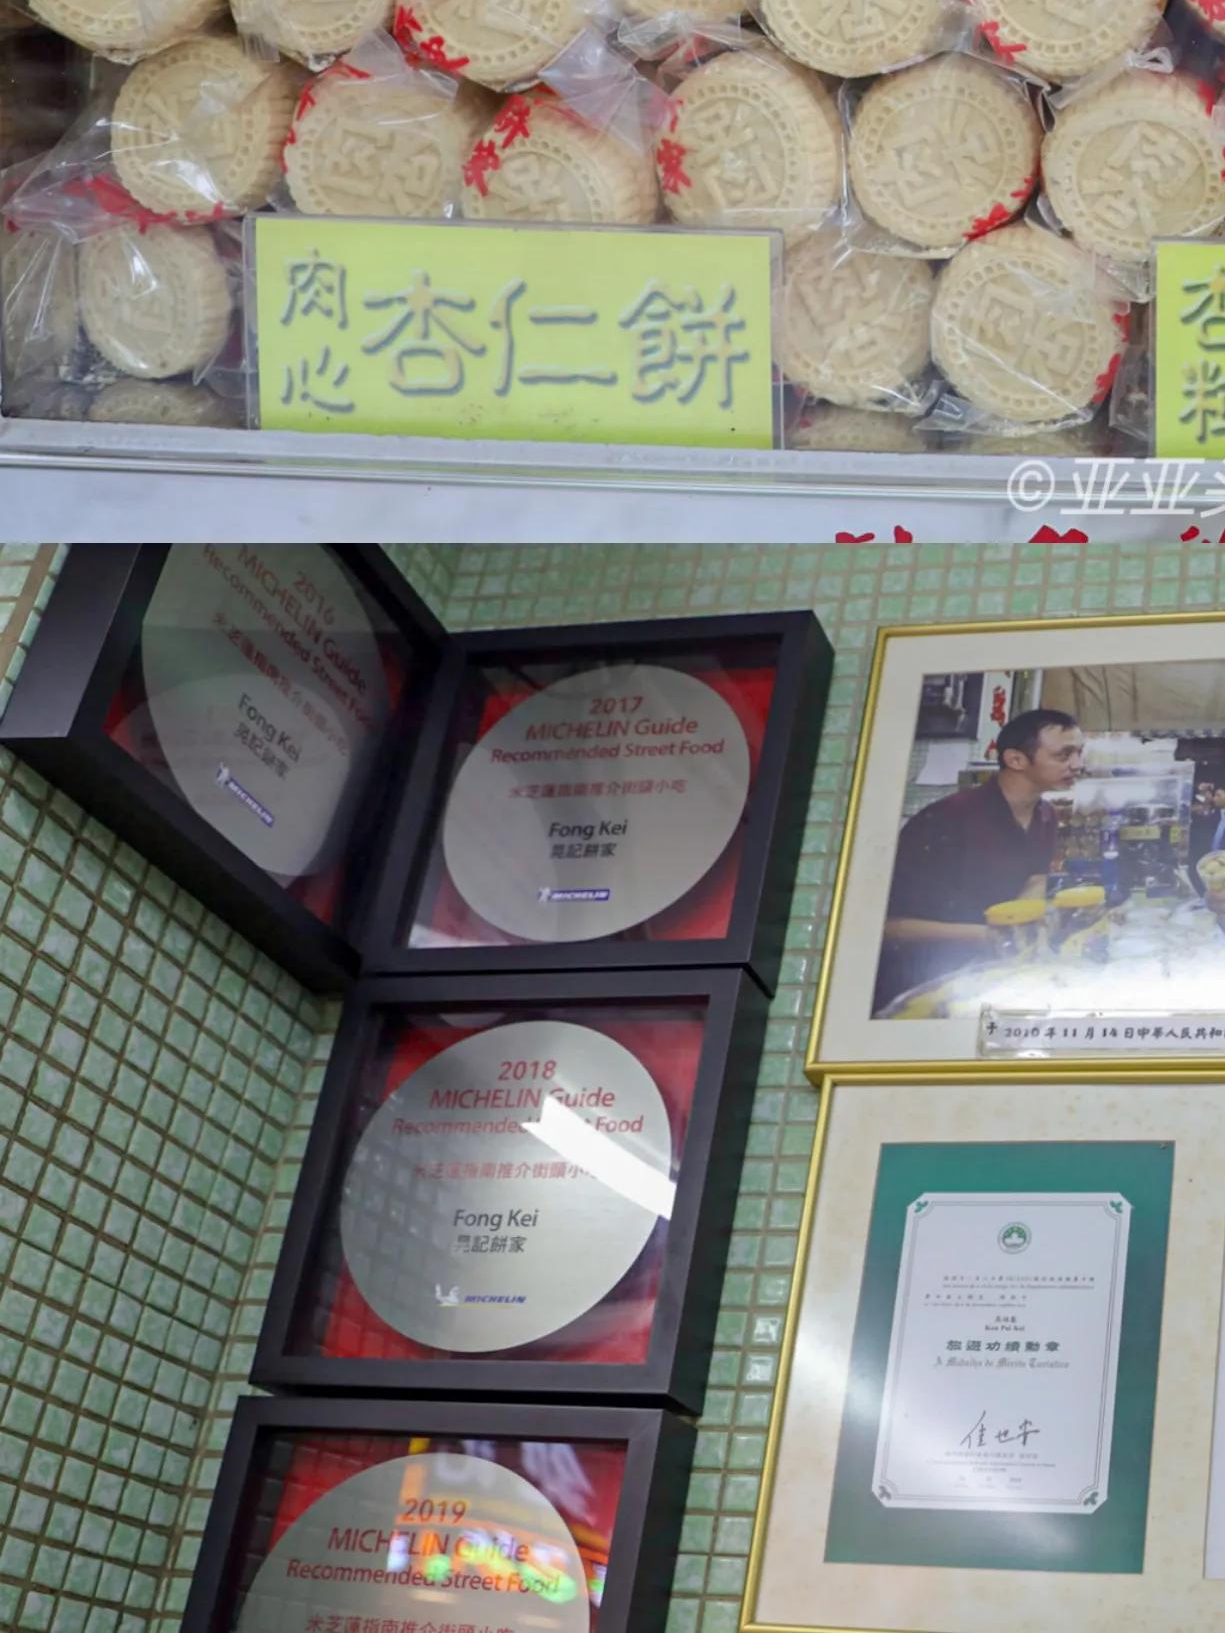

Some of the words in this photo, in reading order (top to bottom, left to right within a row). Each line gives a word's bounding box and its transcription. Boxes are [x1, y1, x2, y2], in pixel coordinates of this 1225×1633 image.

[280, 248, 355, 414] 肉心
[362, 269, 750, 410] 杏仁餅
[589, 696, 643, 714] 2017
[239, 693, 276, 742] Fong
[278, 731, 300, 763] Kei
[525, 720, 629, 741] MICHELIN
[634, 717, 699, 736] Guide
[491, 745, 619, 764] Recommended
[625, 742, 675, 758] Street
[679, 739, 724, 755] Food
[549, 822, 595, 841] Fong
[599, 820, 628, 837] Kei
[551, 889, 609, 901] MICHELIN
[498, 1061, 557, 1080] 2018
[430, 1089, 543, 1110] MICHELIN
[549, 1087, 616, 1108] Guide
[596, 1116, 644, 1133] Food
[454, 1209, 501, 1230] Fong
[507, 1208, 538, 1228] Kei
[464, 1294, 526, 1304] MICHELIN
[402, 1498, 467, 1523] 2019
[328, 1527, 448, 1555] MICHELIN
[287, 1559, 436, 1587] Recommended
[441, 1570, 501, 1591] Street
